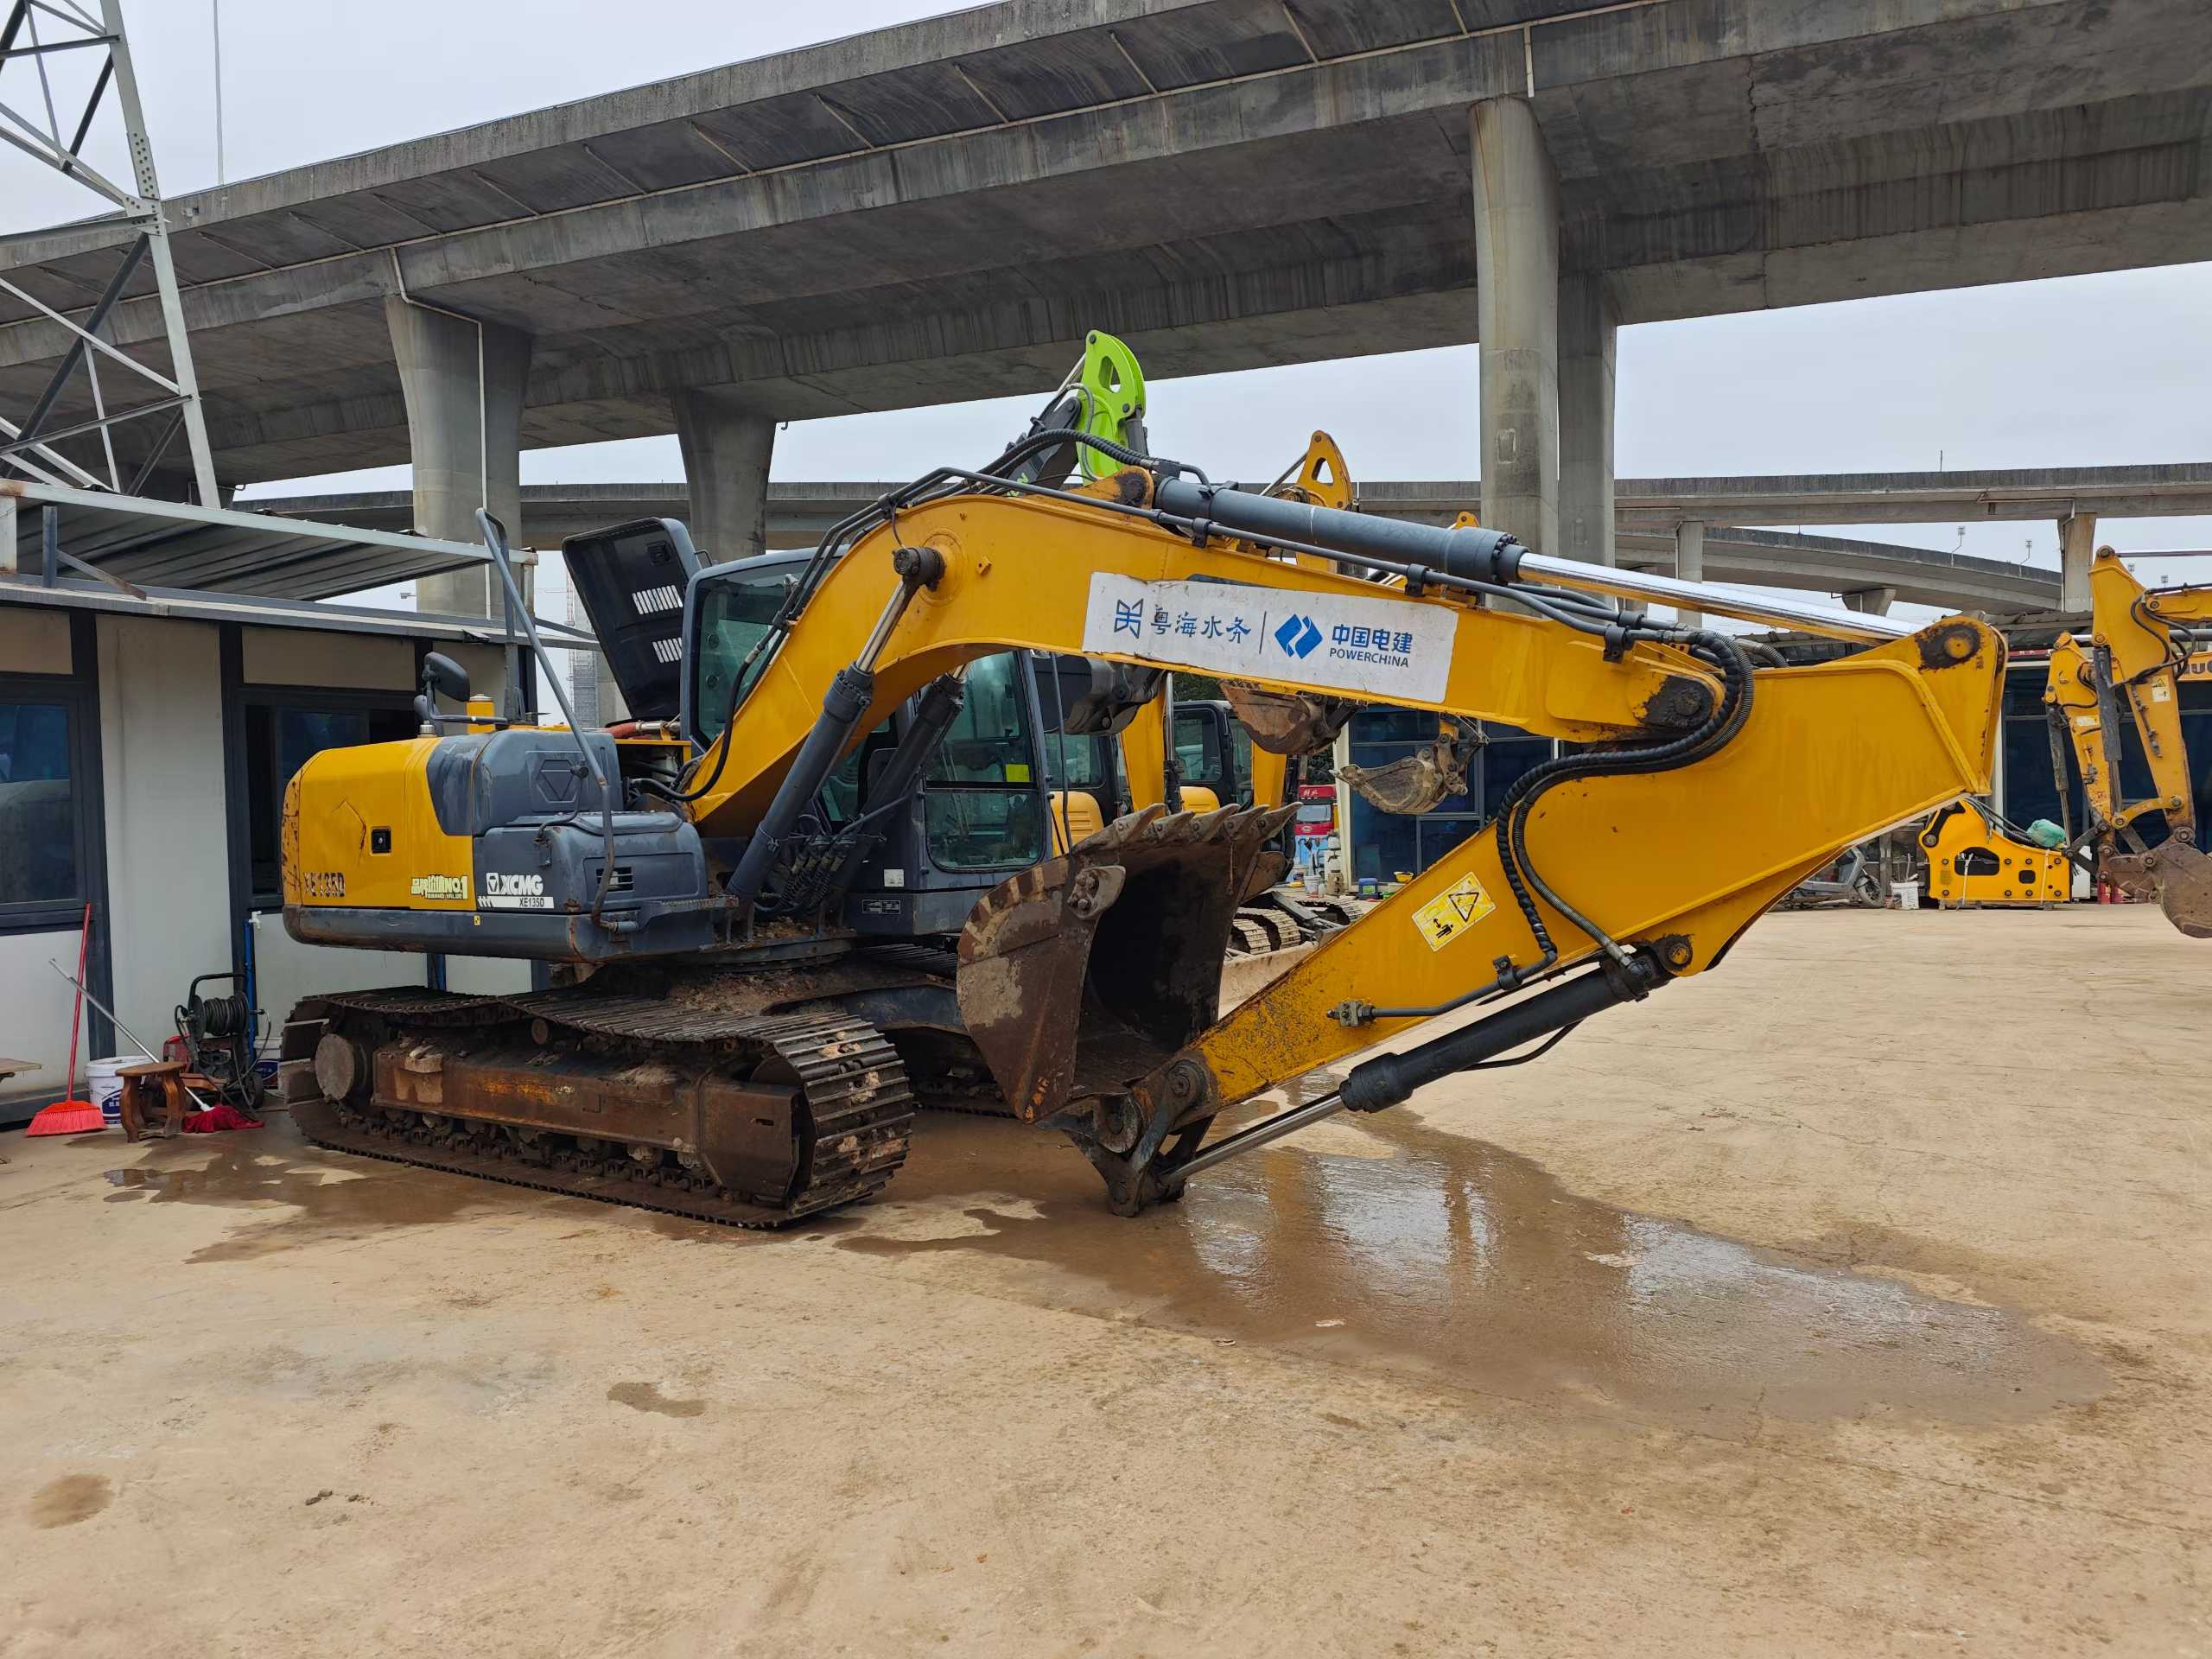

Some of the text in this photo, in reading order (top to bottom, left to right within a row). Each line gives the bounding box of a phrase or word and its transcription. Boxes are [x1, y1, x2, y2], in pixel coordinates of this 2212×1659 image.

[1151, 604, 1251, 644] 粤海水务
[1332, 625, 1413, 654] 中国电建
[1330, 647, 1409, 668] POWERCHINA
[500, 874, 543, 896] XCMG
[519, 898, 544, 908] XE135D
